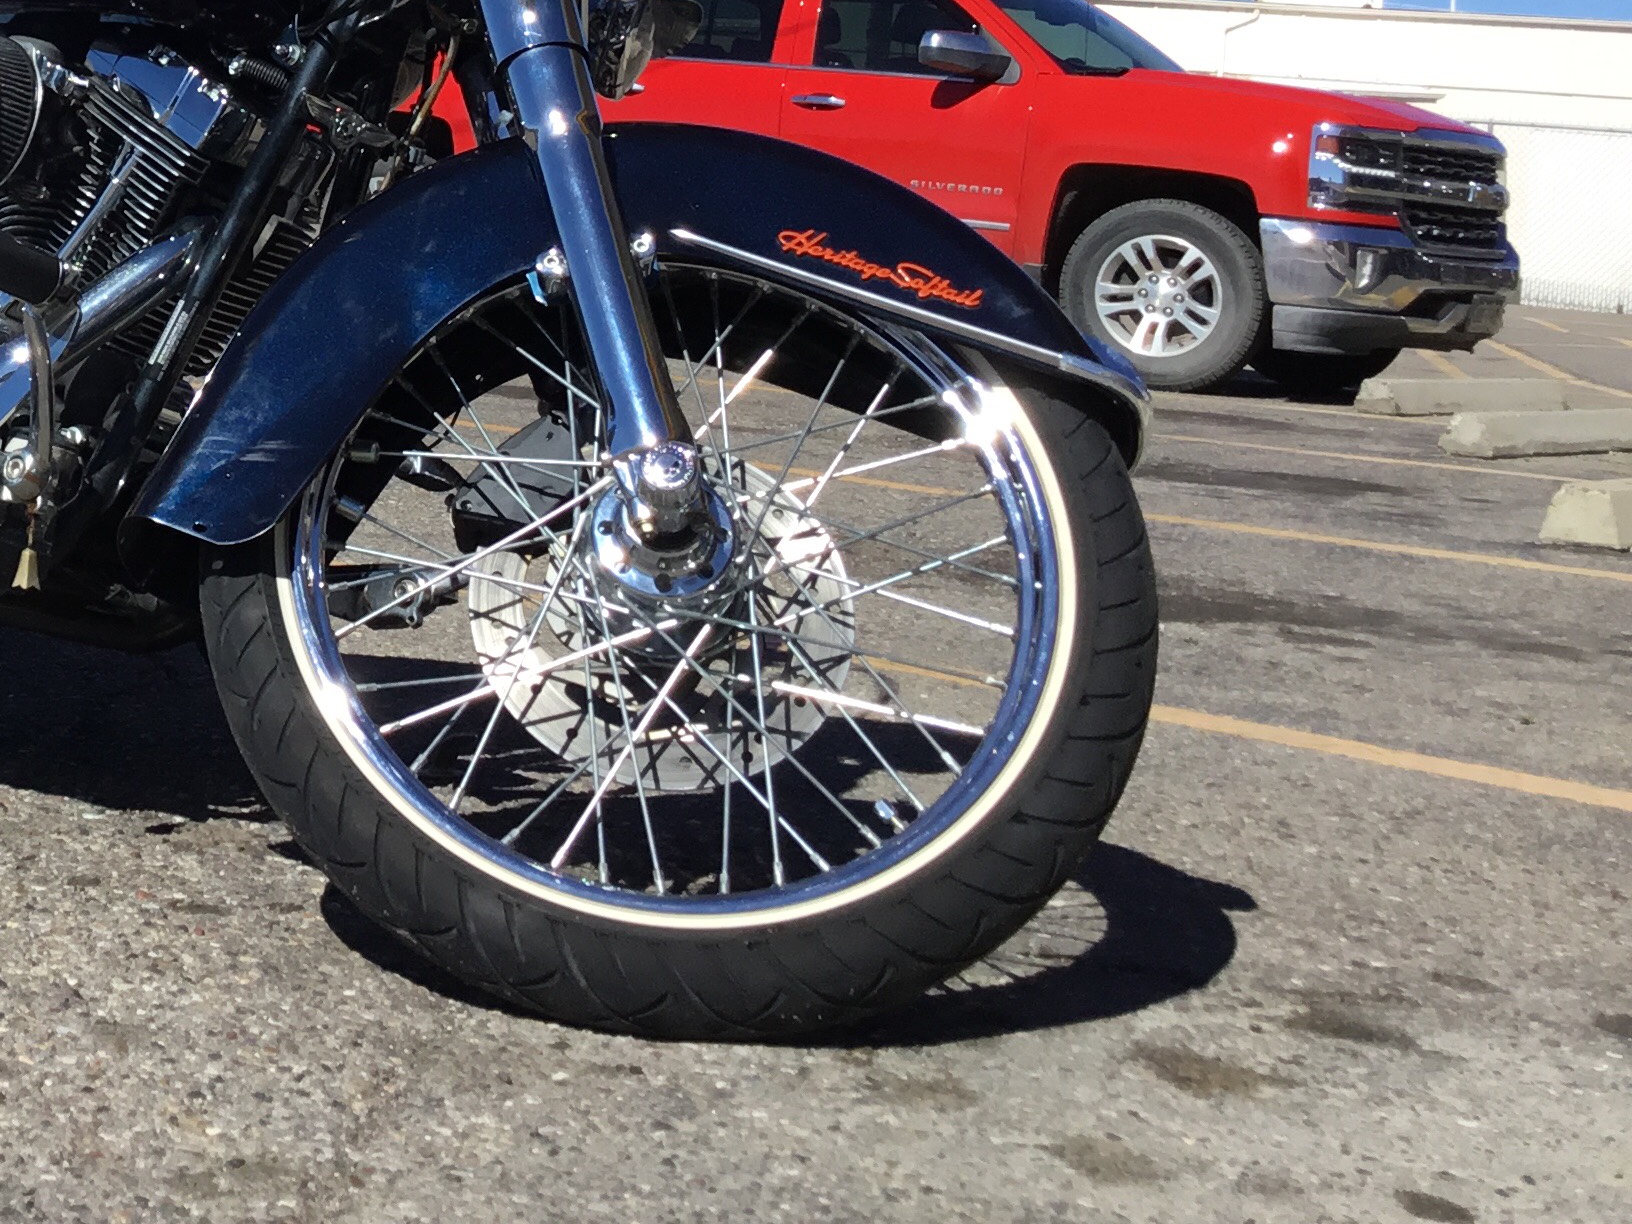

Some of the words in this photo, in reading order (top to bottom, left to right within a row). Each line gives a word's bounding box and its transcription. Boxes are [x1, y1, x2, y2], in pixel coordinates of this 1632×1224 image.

[909, 179, 1004, 197] SILVERADO
[777, 228, 892, 281] Heritage
[887, 261, 983, 309] Softail
